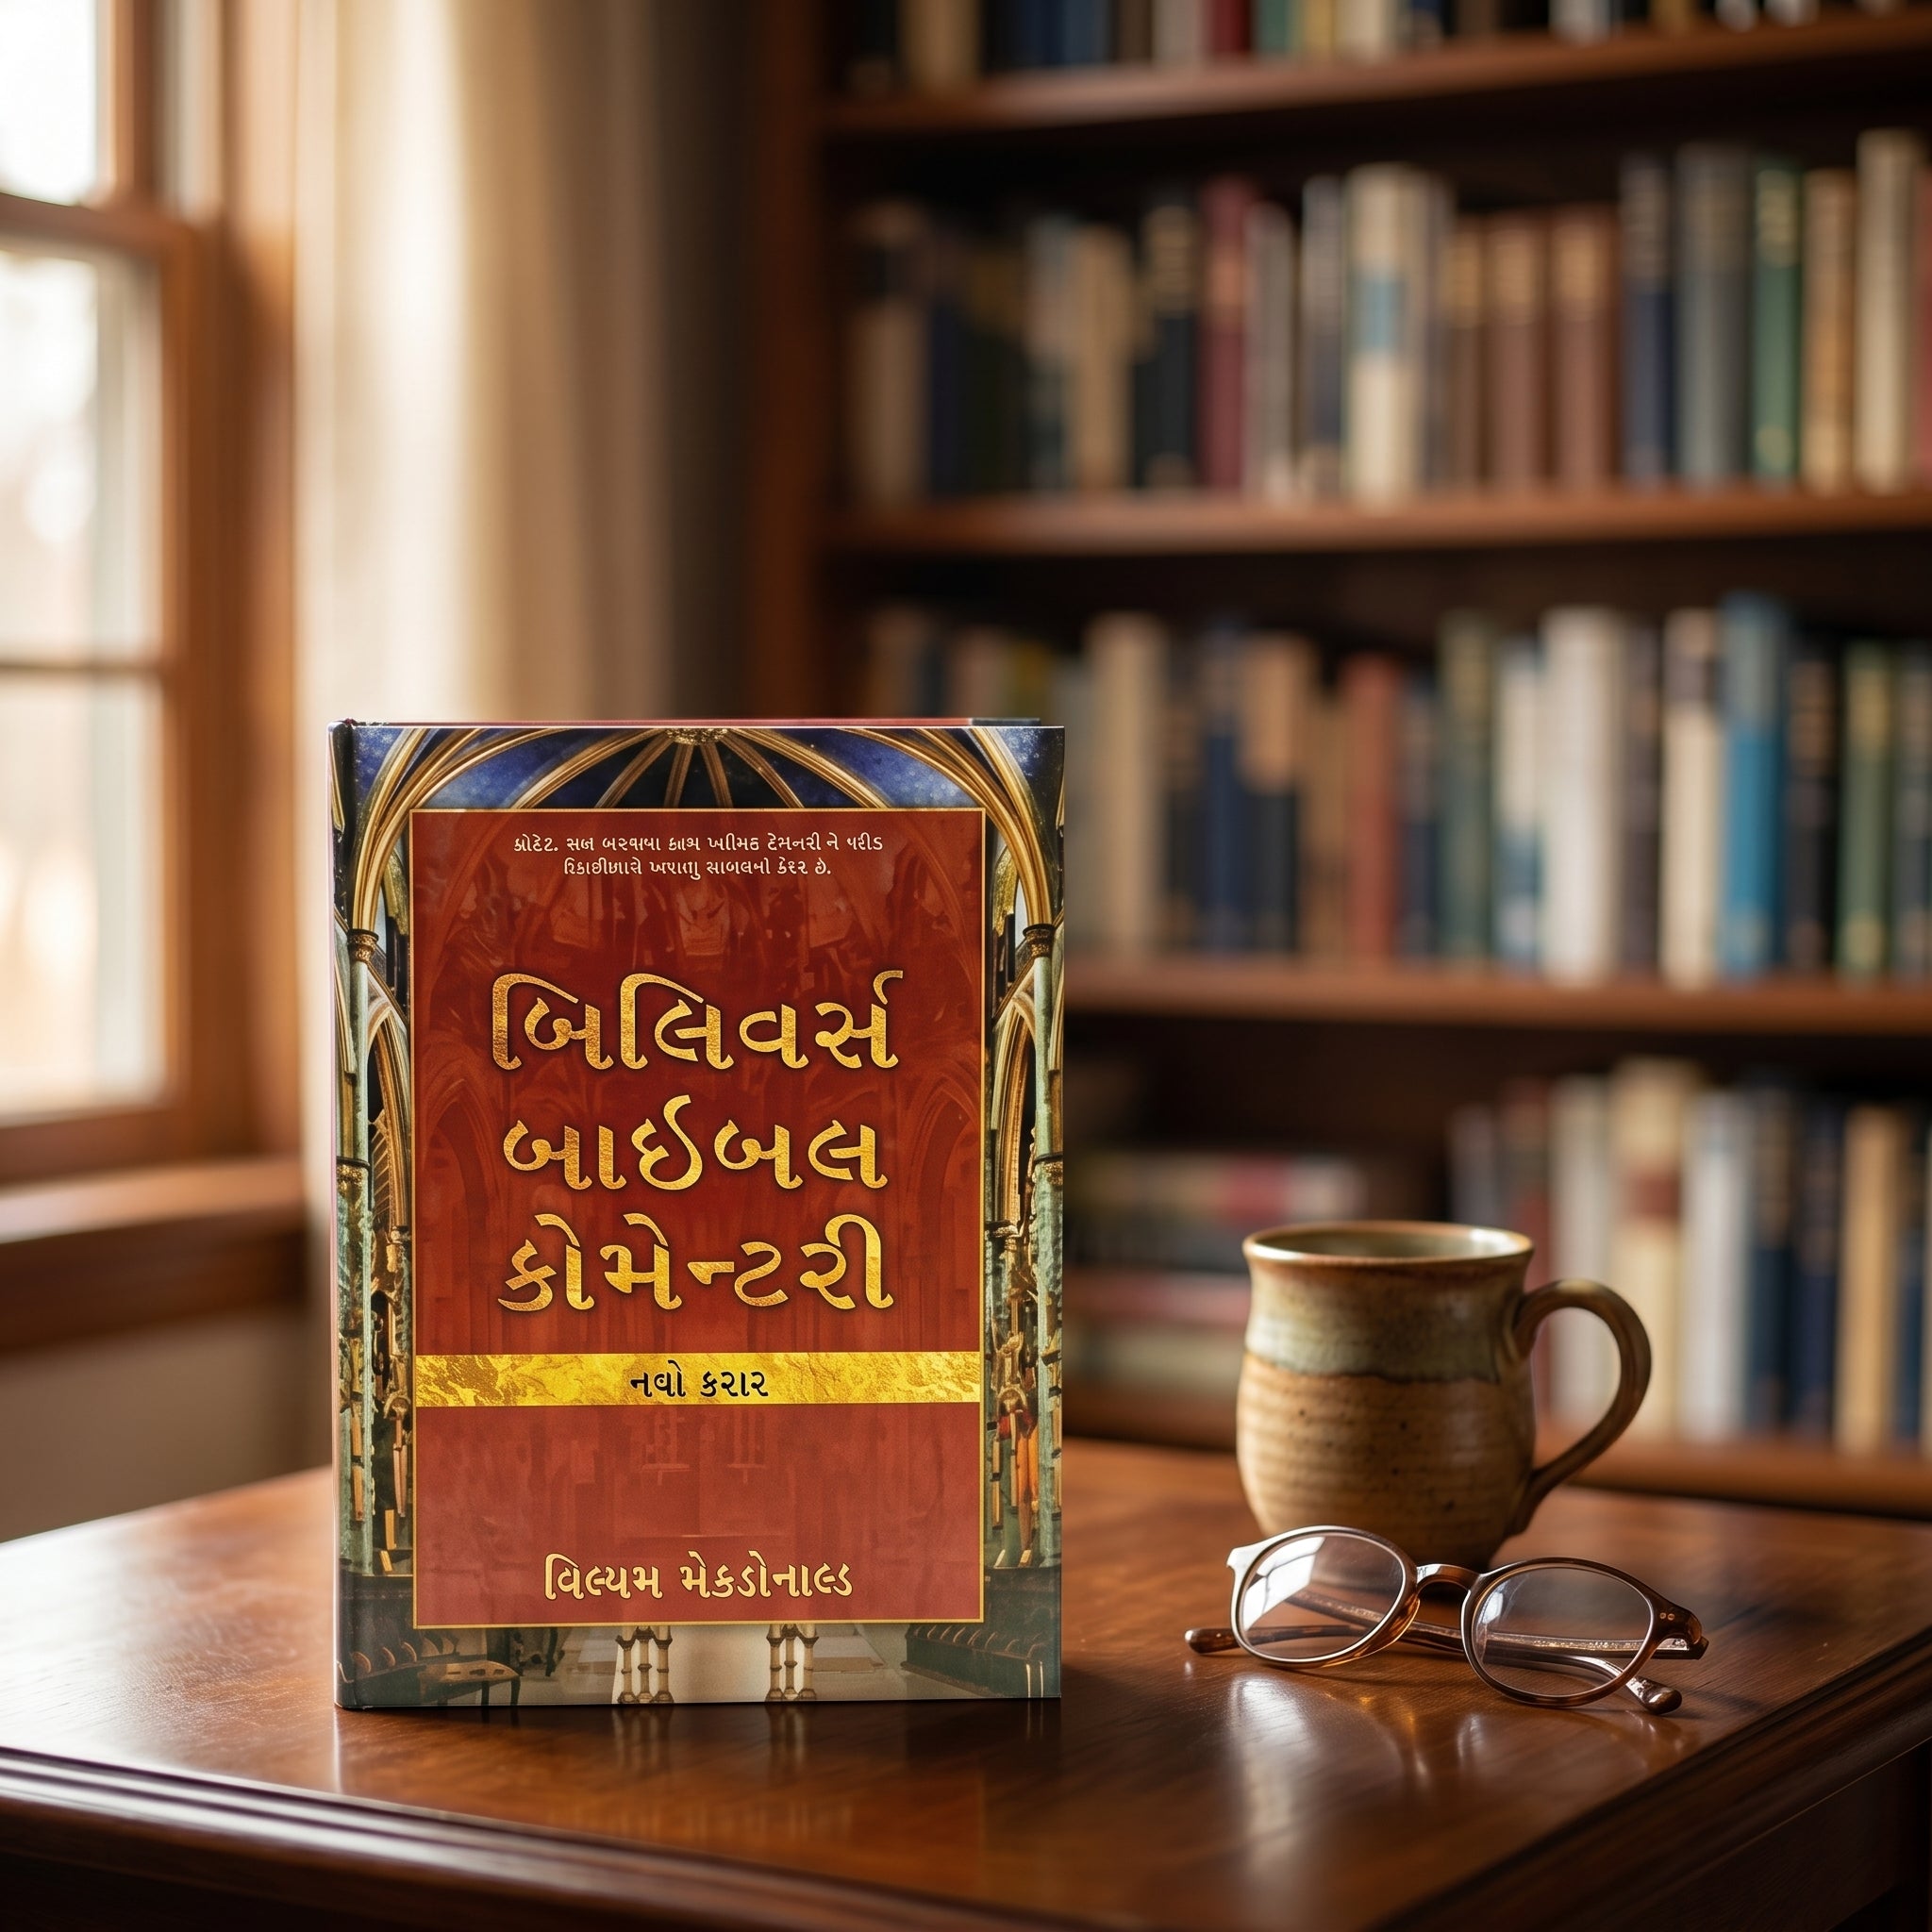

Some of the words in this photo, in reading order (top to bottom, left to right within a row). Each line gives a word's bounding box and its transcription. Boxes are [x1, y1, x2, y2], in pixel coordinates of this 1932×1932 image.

[491, 970, 904, 1070] બિલિવર્સ
[503, 1094, 889, 1191] બાઈબલ
[497, 1212, 894, 1311] કોમેન્ટરી
[629, 1359, 687, 1398] નવો
[700, 1370, 769, 1398] કરાર
[544, 1553, 664, 1600] વિલ્યમ
[678, 1550, 854, 1599] મેકડોનાલ્ડ
